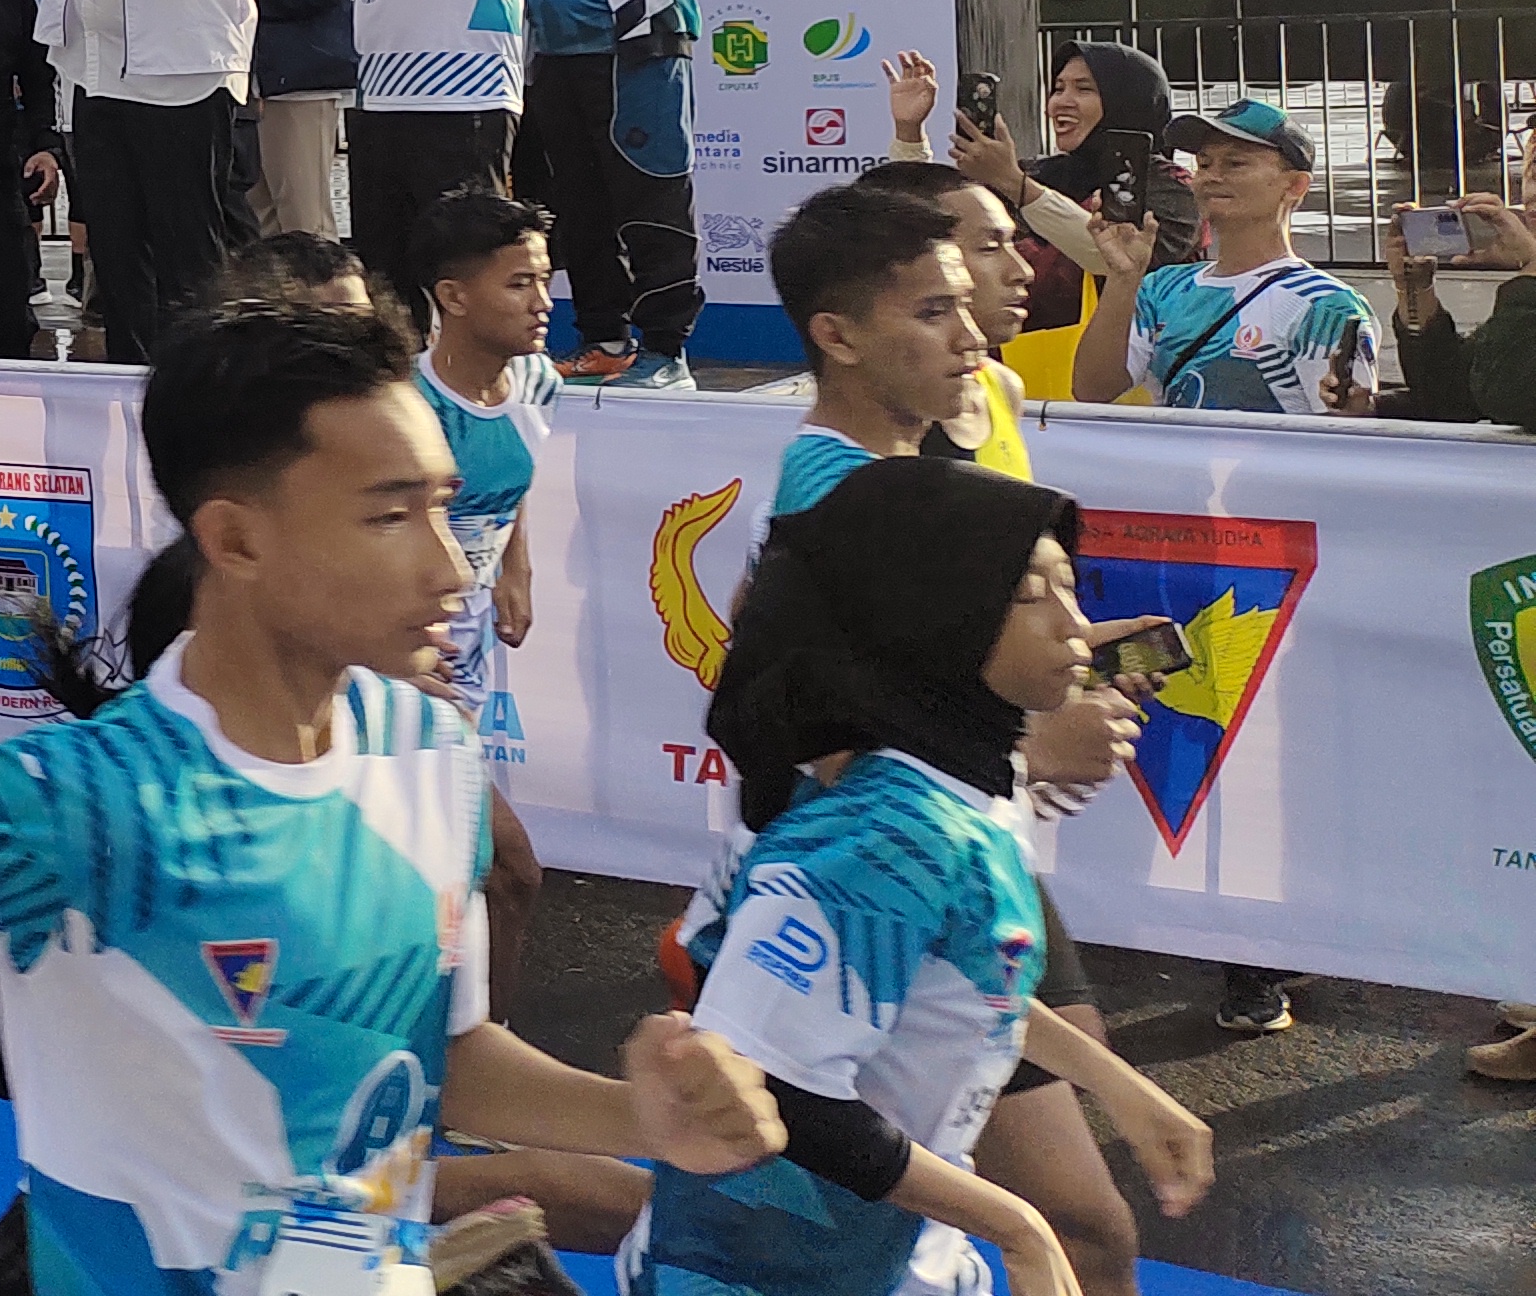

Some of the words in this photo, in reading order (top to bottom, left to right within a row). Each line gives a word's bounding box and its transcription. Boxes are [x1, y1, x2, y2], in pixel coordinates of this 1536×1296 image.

[694, 129, 740, 143] media
[695, 146, 741, 157] ntara
[34, 473, 85, 495] SELATAN
[1484, 621, 1536, 747] Persatua
